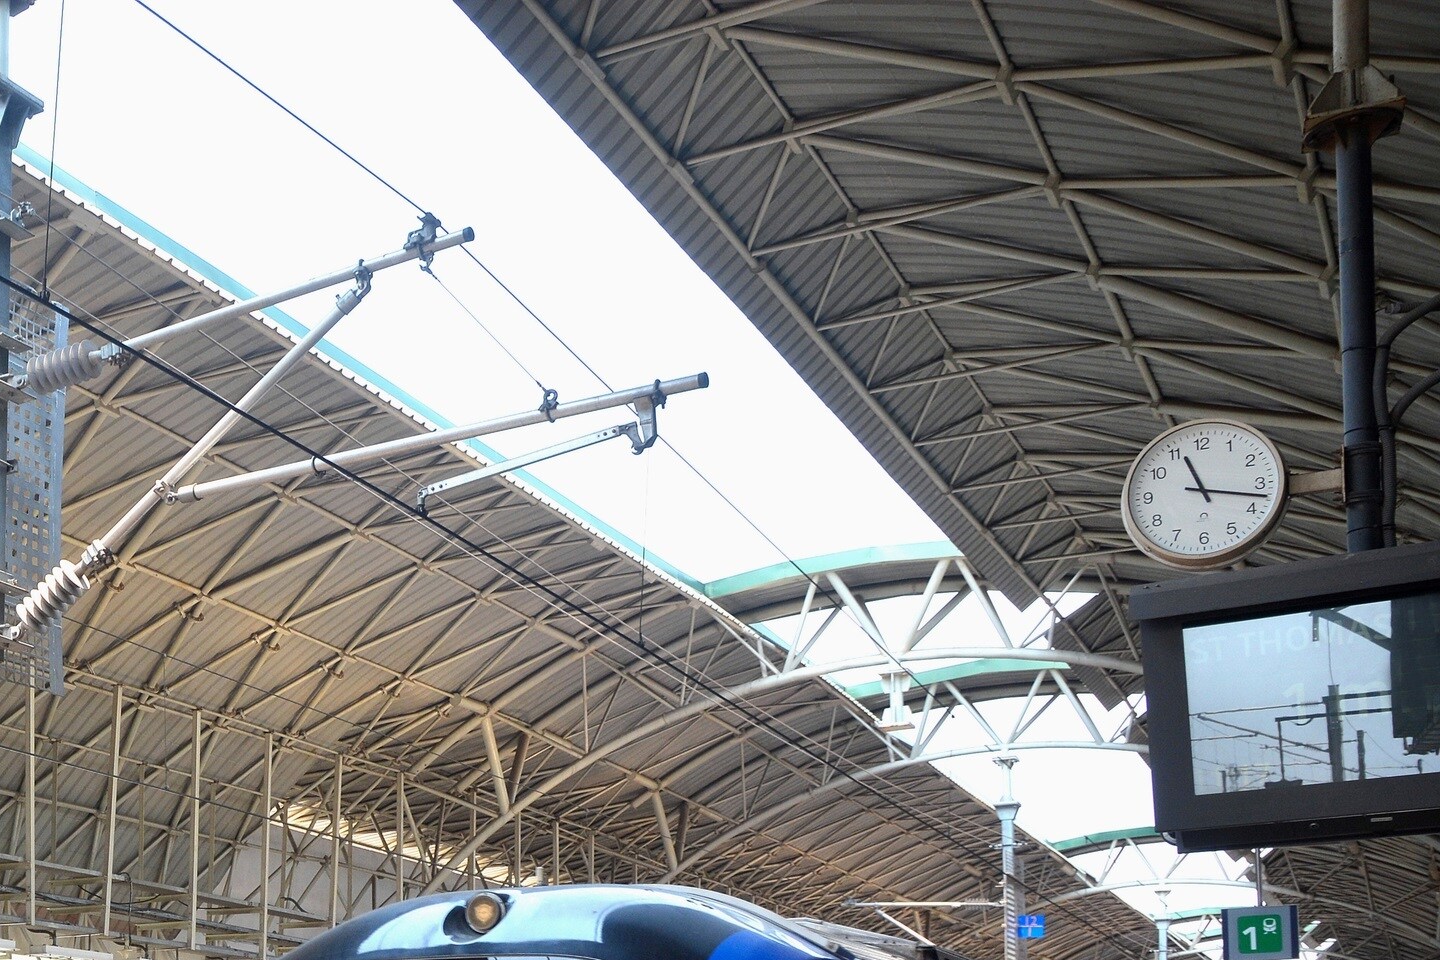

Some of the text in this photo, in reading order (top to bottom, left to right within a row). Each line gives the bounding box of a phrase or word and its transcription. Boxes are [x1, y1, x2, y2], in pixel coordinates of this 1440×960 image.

[1193, 437, 1210, 451] 12
[1225, 439, 1232, 452] 1
[1168, 447, 1181, 461] 11
[1245, 453, 1256, 468] 2
[1149, 466, 1167, 480] 10
[1254, 476, 1266, 490] 3
[1143, 491, 1154, 505] 9
[1246, 502, 1257, 515] 4
[1151, 514, 1163, 527] 8
[1226, 521, 1237, 535] 5
[1172, 529, 1181, 542] 7
[1199, 531, 1210, 545] 6
[1190, 635, 1226, 664] ST
[1242, 926, 1258, 951] 1
